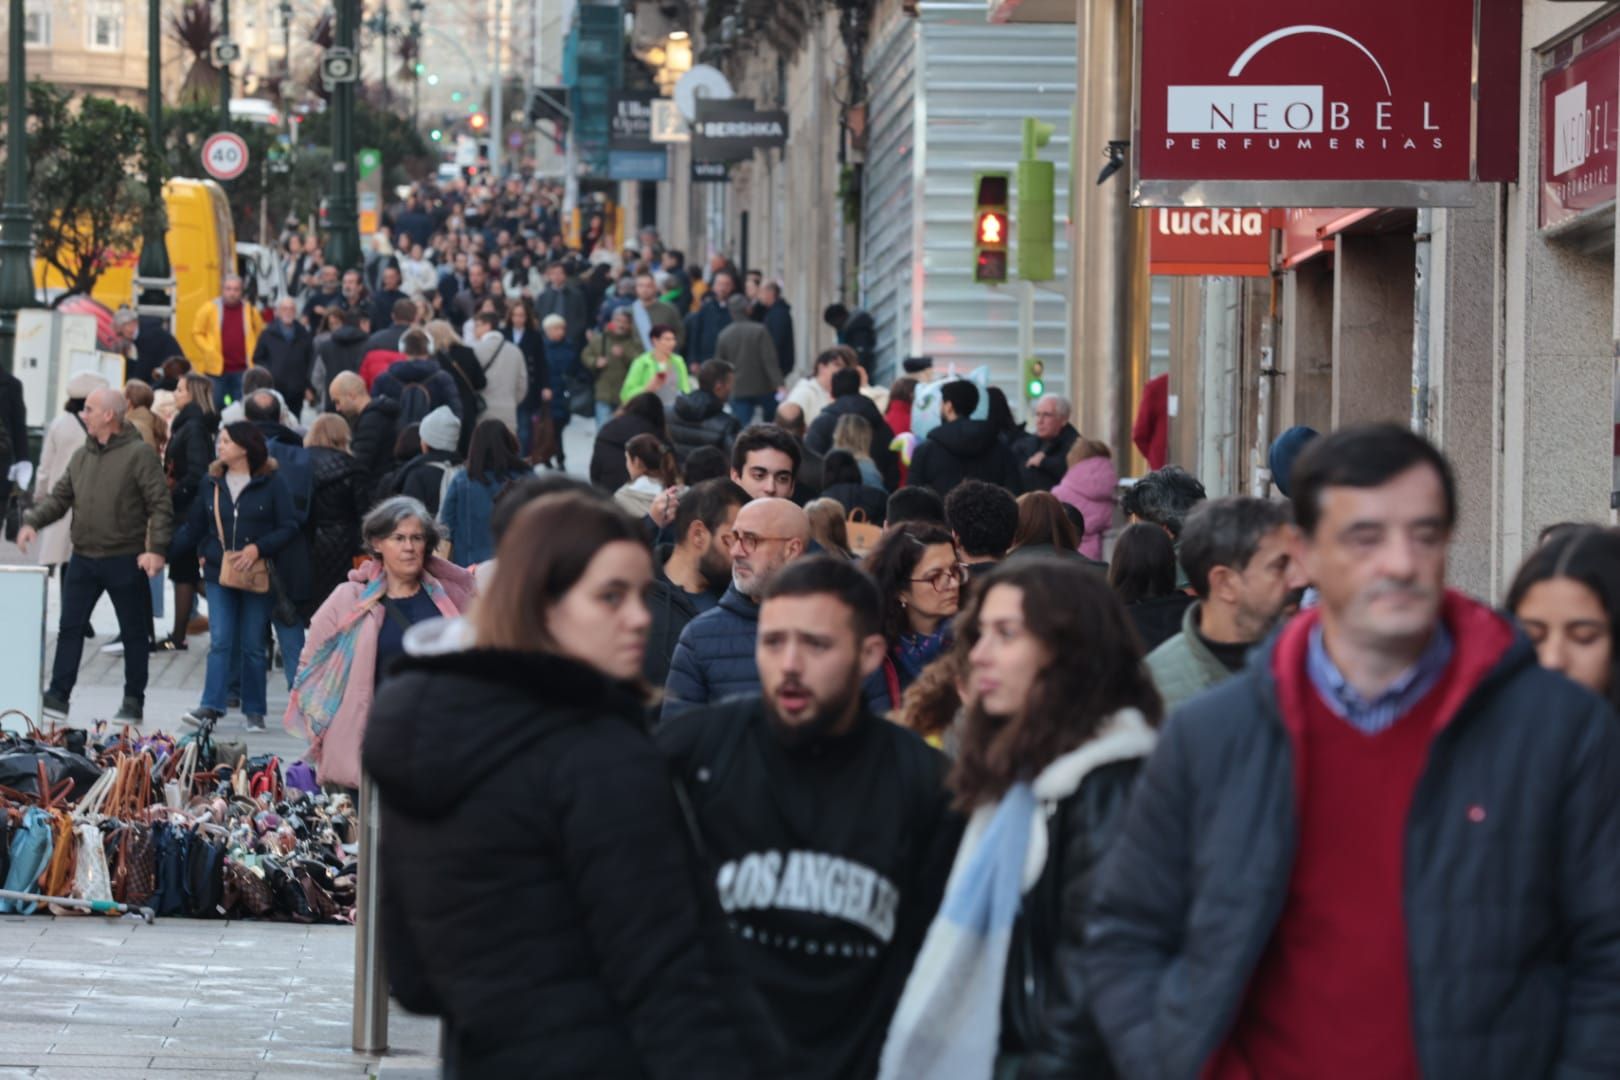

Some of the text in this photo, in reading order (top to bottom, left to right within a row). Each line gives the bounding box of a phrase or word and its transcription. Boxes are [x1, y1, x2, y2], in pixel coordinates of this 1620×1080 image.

[1210, 101, 1440, 131] NEOBEL
[704, 121, 783, 138] BERSHKA
[1561, 101, 1609, 169] NEOBEL
[1165, 138, 1443, 150] PERFUMERIAS
[212, 148, 238, 163] 40
[1159, 208, 1262, 236] luckia
